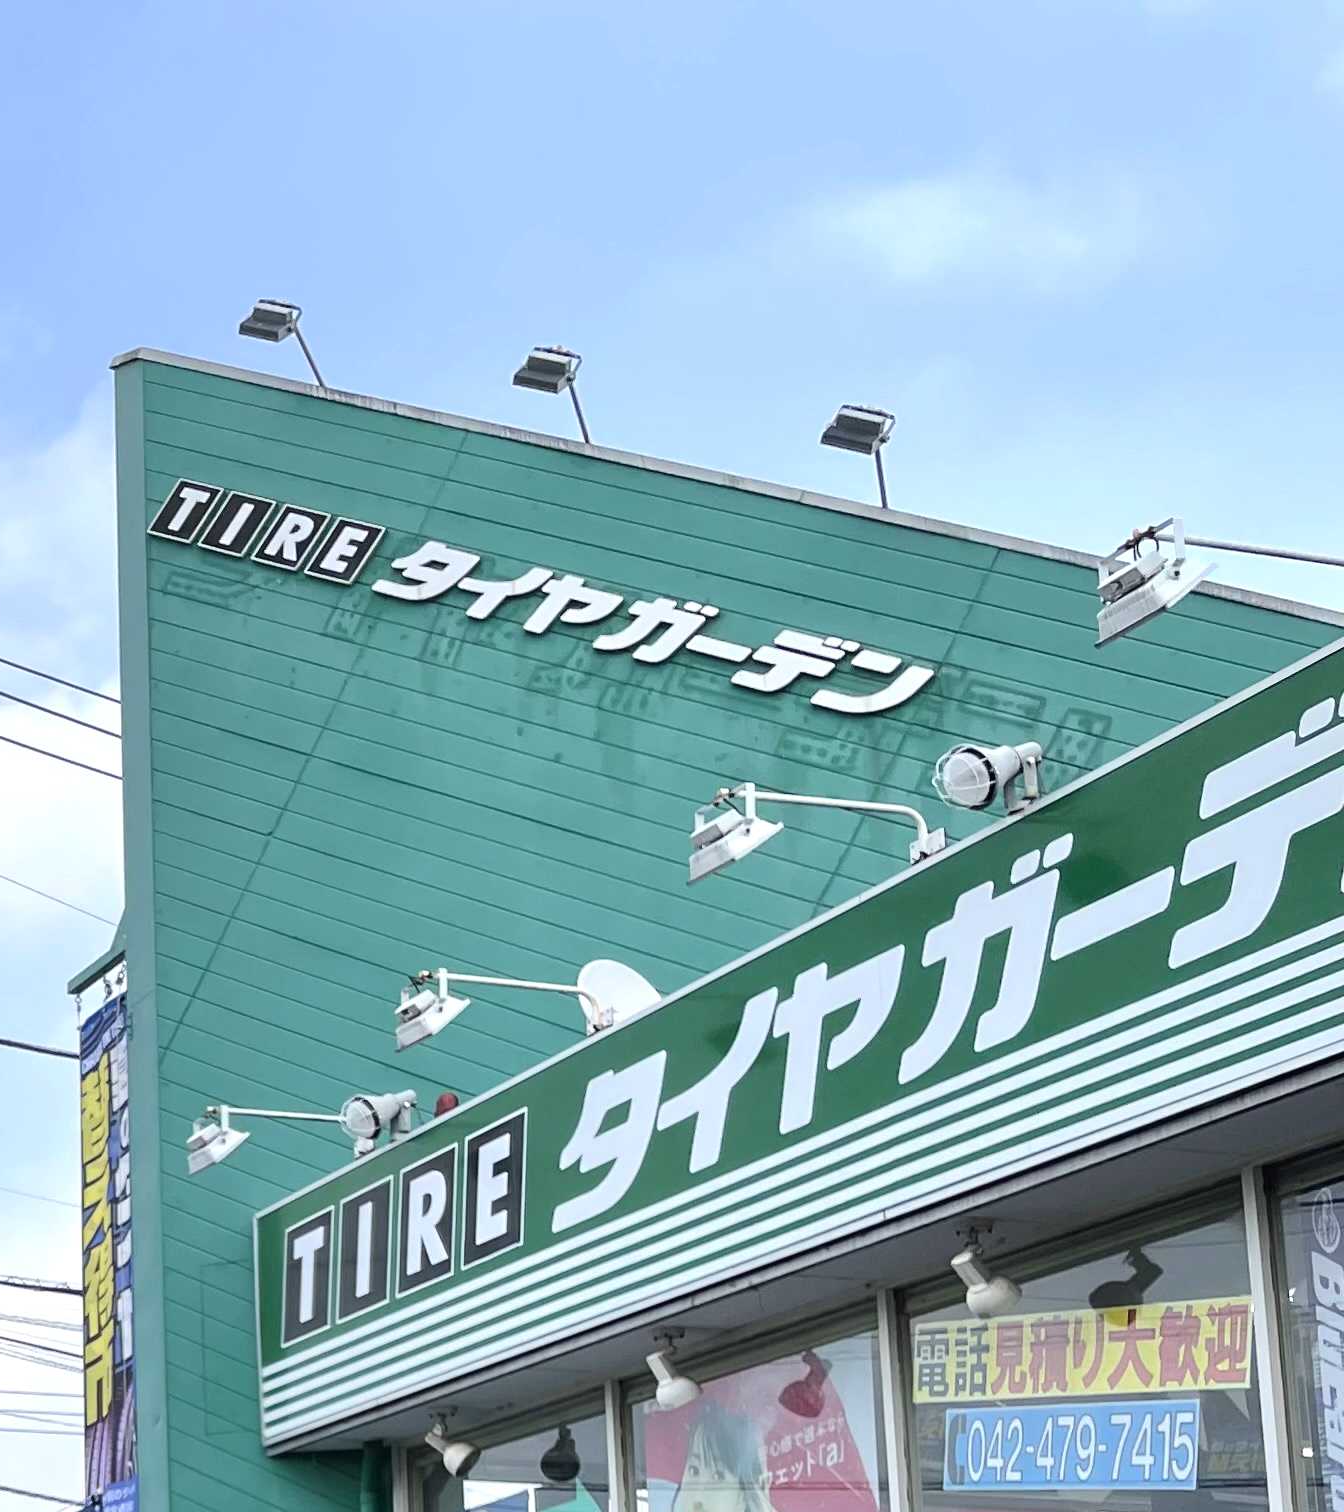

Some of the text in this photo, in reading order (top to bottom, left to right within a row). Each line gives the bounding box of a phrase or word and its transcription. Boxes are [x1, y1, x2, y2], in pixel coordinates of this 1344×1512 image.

[162, 486, 936, 714] TIRE タイヤガーデン
[291, 694, 1344, 1324] TIRE タイヤガーデ
[916, 1303, 1249, 1398] 電話見積り大歓迎
[967, 1411, 1194, 1483] 042-479-7415
